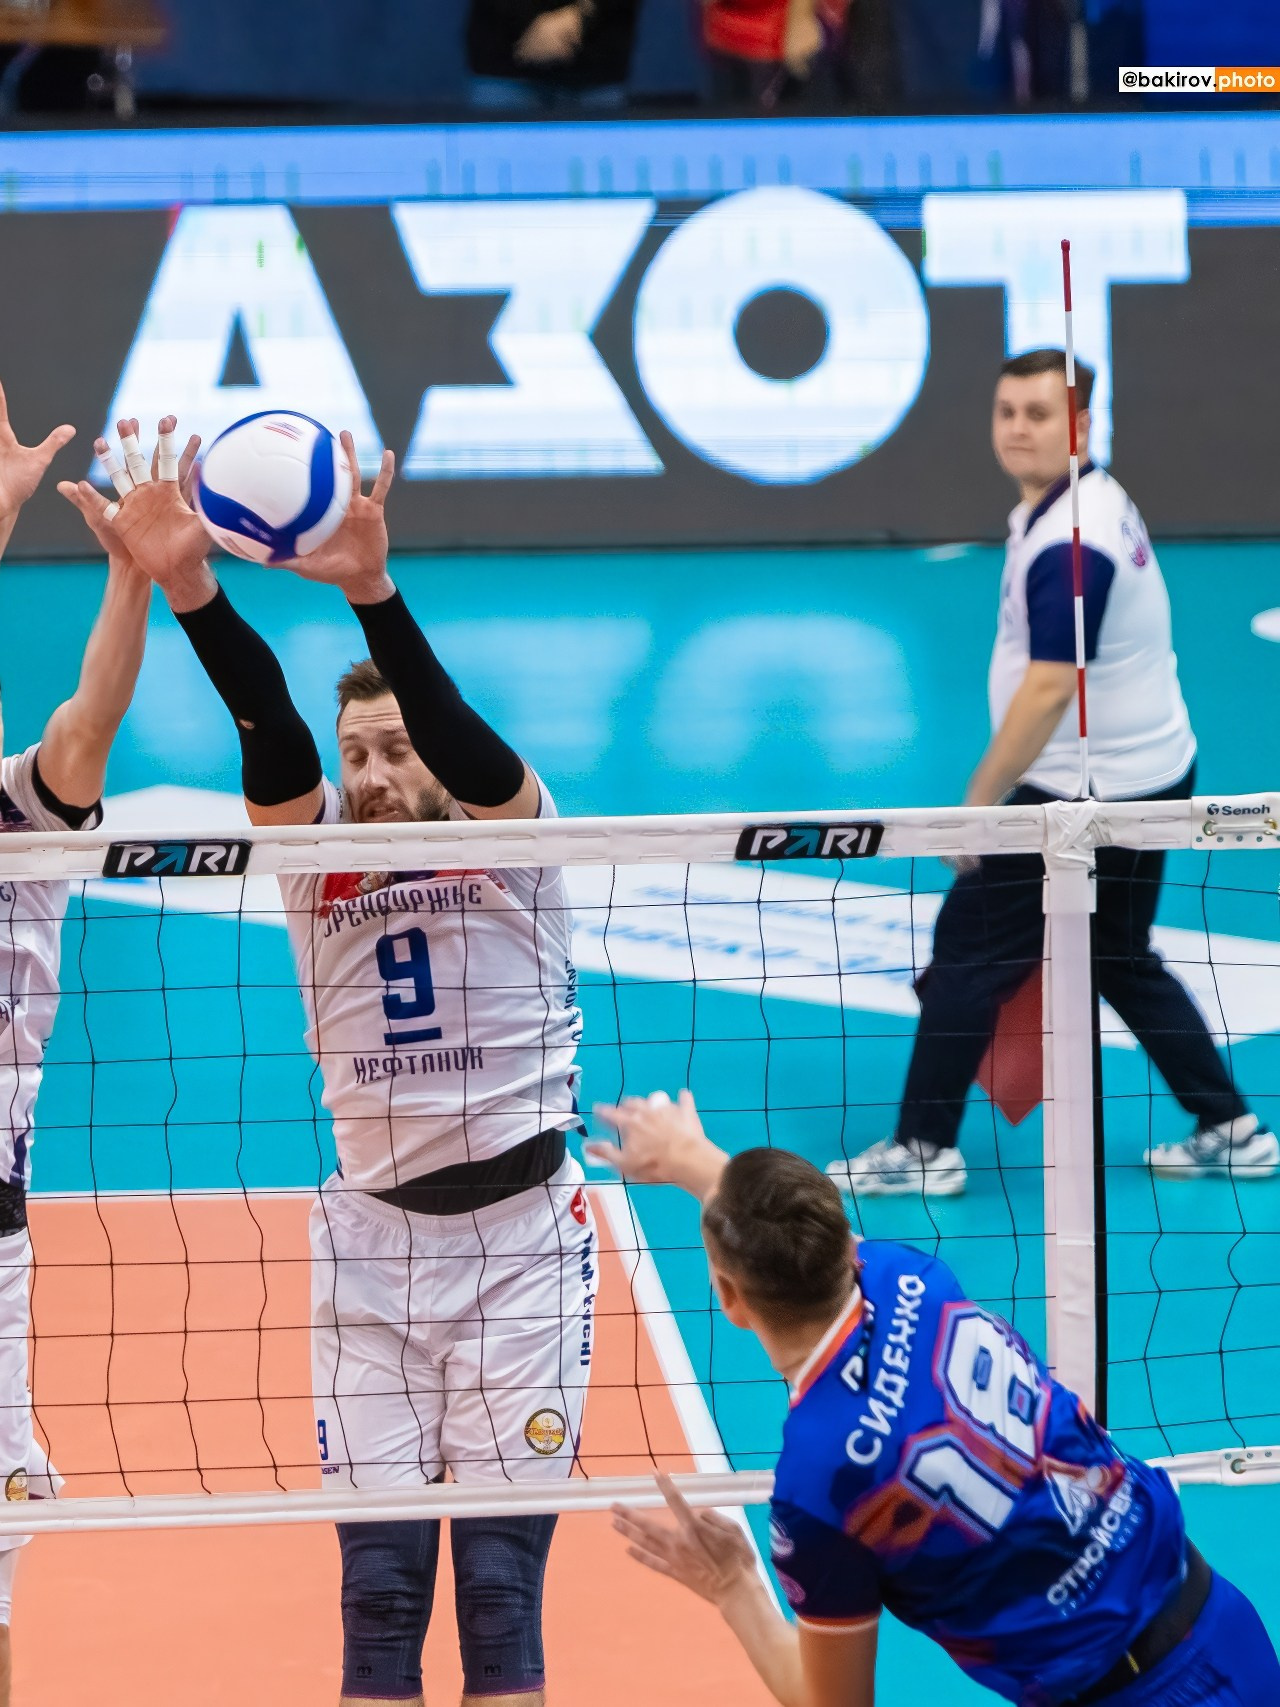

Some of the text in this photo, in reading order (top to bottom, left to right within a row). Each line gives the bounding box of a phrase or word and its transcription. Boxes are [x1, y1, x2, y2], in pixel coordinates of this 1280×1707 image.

[91, 184, 1191, 487] АЗОТ
[749, 827, 872, 856] PARI
[1222, 804, 1270, 816] Senoh
[117, 844, 240, 873] PARI
[375, 926, 436, 1021] 9
[353, 1046, 484, 1085] НЕФТЯНИК
[846, 1274, 926, 1466] СИДЕНКО
[904, 1306, 1049, 1537] 18
